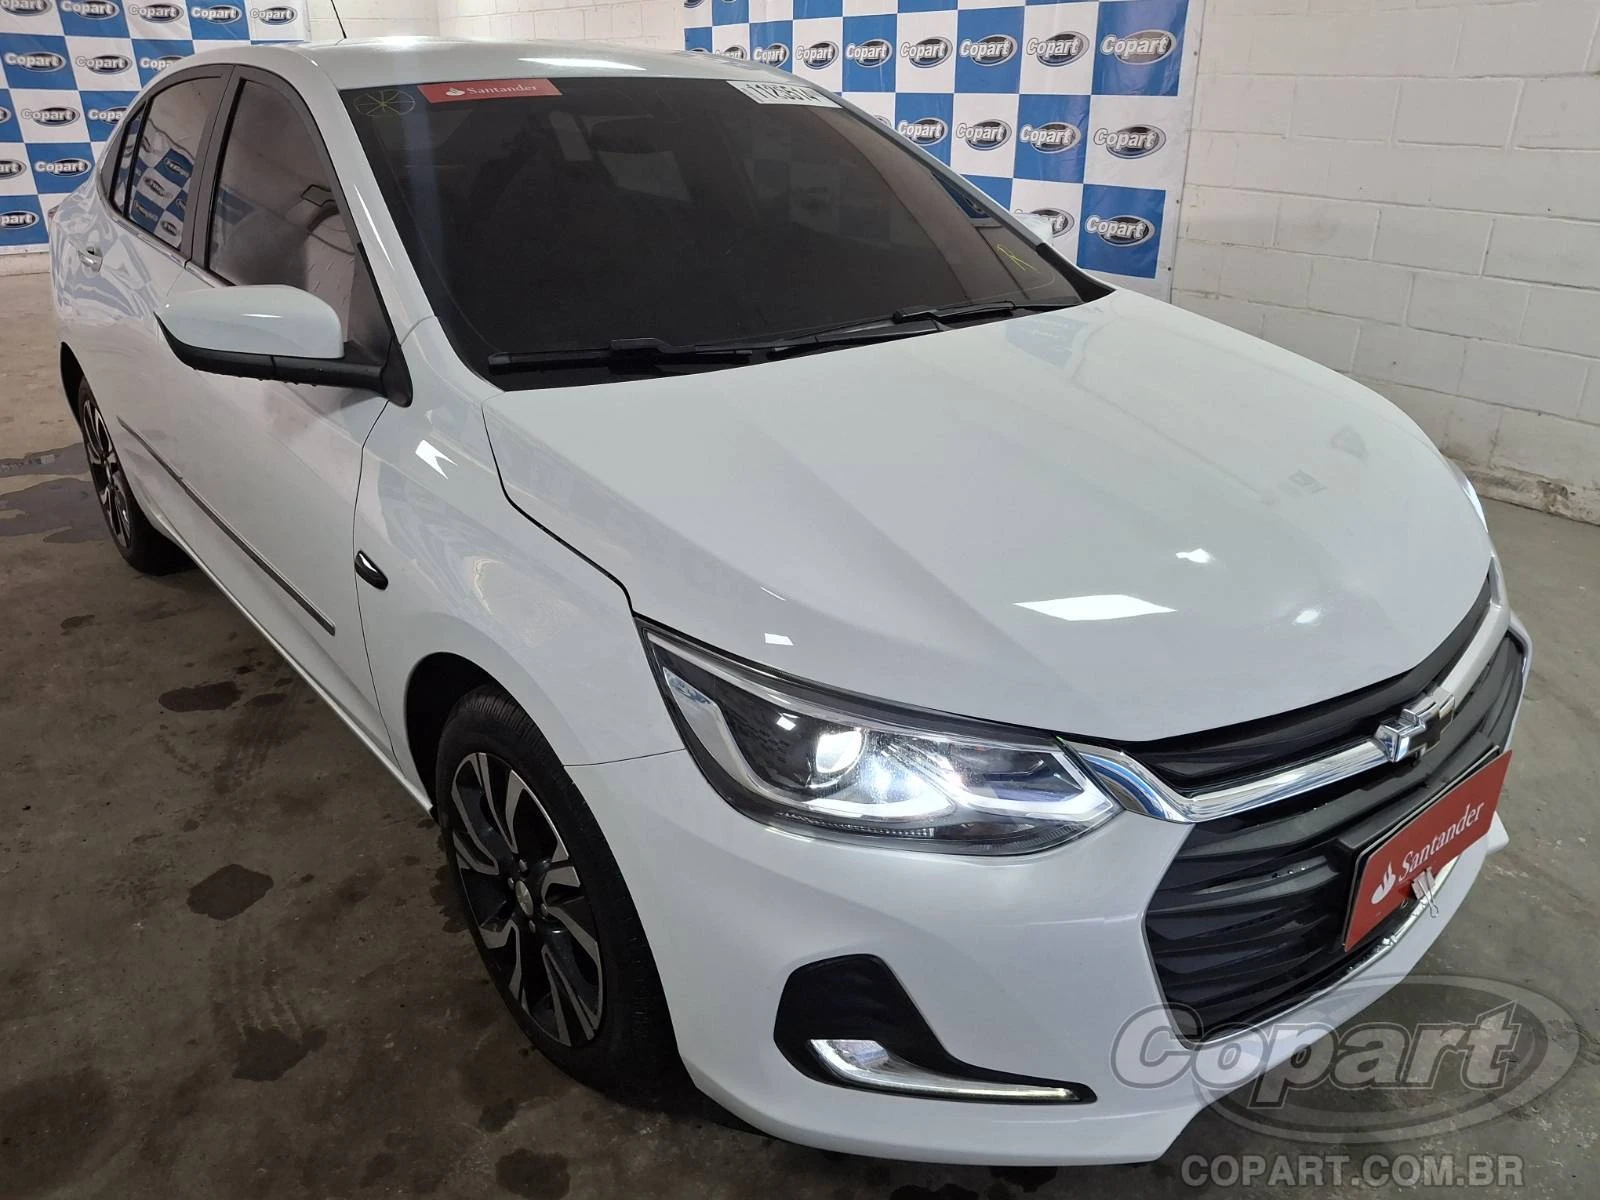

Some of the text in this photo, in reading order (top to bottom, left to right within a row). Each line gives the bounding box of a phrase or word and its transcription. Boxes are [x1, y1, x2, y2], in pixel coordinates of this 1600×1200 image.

[0, 0, 43, 11] opart
[61, 0, 114, 16] Copart
[129, 5, 177, 21] Copart
[191, 7, 237, 20] Copart
[250, 8, 292, 21] Copart
[846, 43, 888, 63] Copart
[900, 41, 946, 62] Copart
[959, 39, 1010, 61] Copart
[1026, 37, 1080, 60] Copart
[1101, 34, 1169, 59] Copart
[4, 52, 59, 68] Copart
[76, 55, 125, 70] Copart
[753, 47, 785, 63] Copart
[796, 46, 833, 64] Copart
[140, 57, 175, 70] Copa
[466, 84, 537, 95] Santander
[21, 108, 73, 121] Copart
[88, 109, 123, 121] Copa
[898, 120, 942, 142] Copart
[955, 123, 1004, 145] Copart
[1020, 124, 1073, 146] Copart
[1093, 127, 1155, 151] Copart
[34, 161, 84, 175] Copart
[0, 211, 33, 226] part
[1085, 215, 1145, 240] Copart
[1398, 802, 1484, 881] Santander
